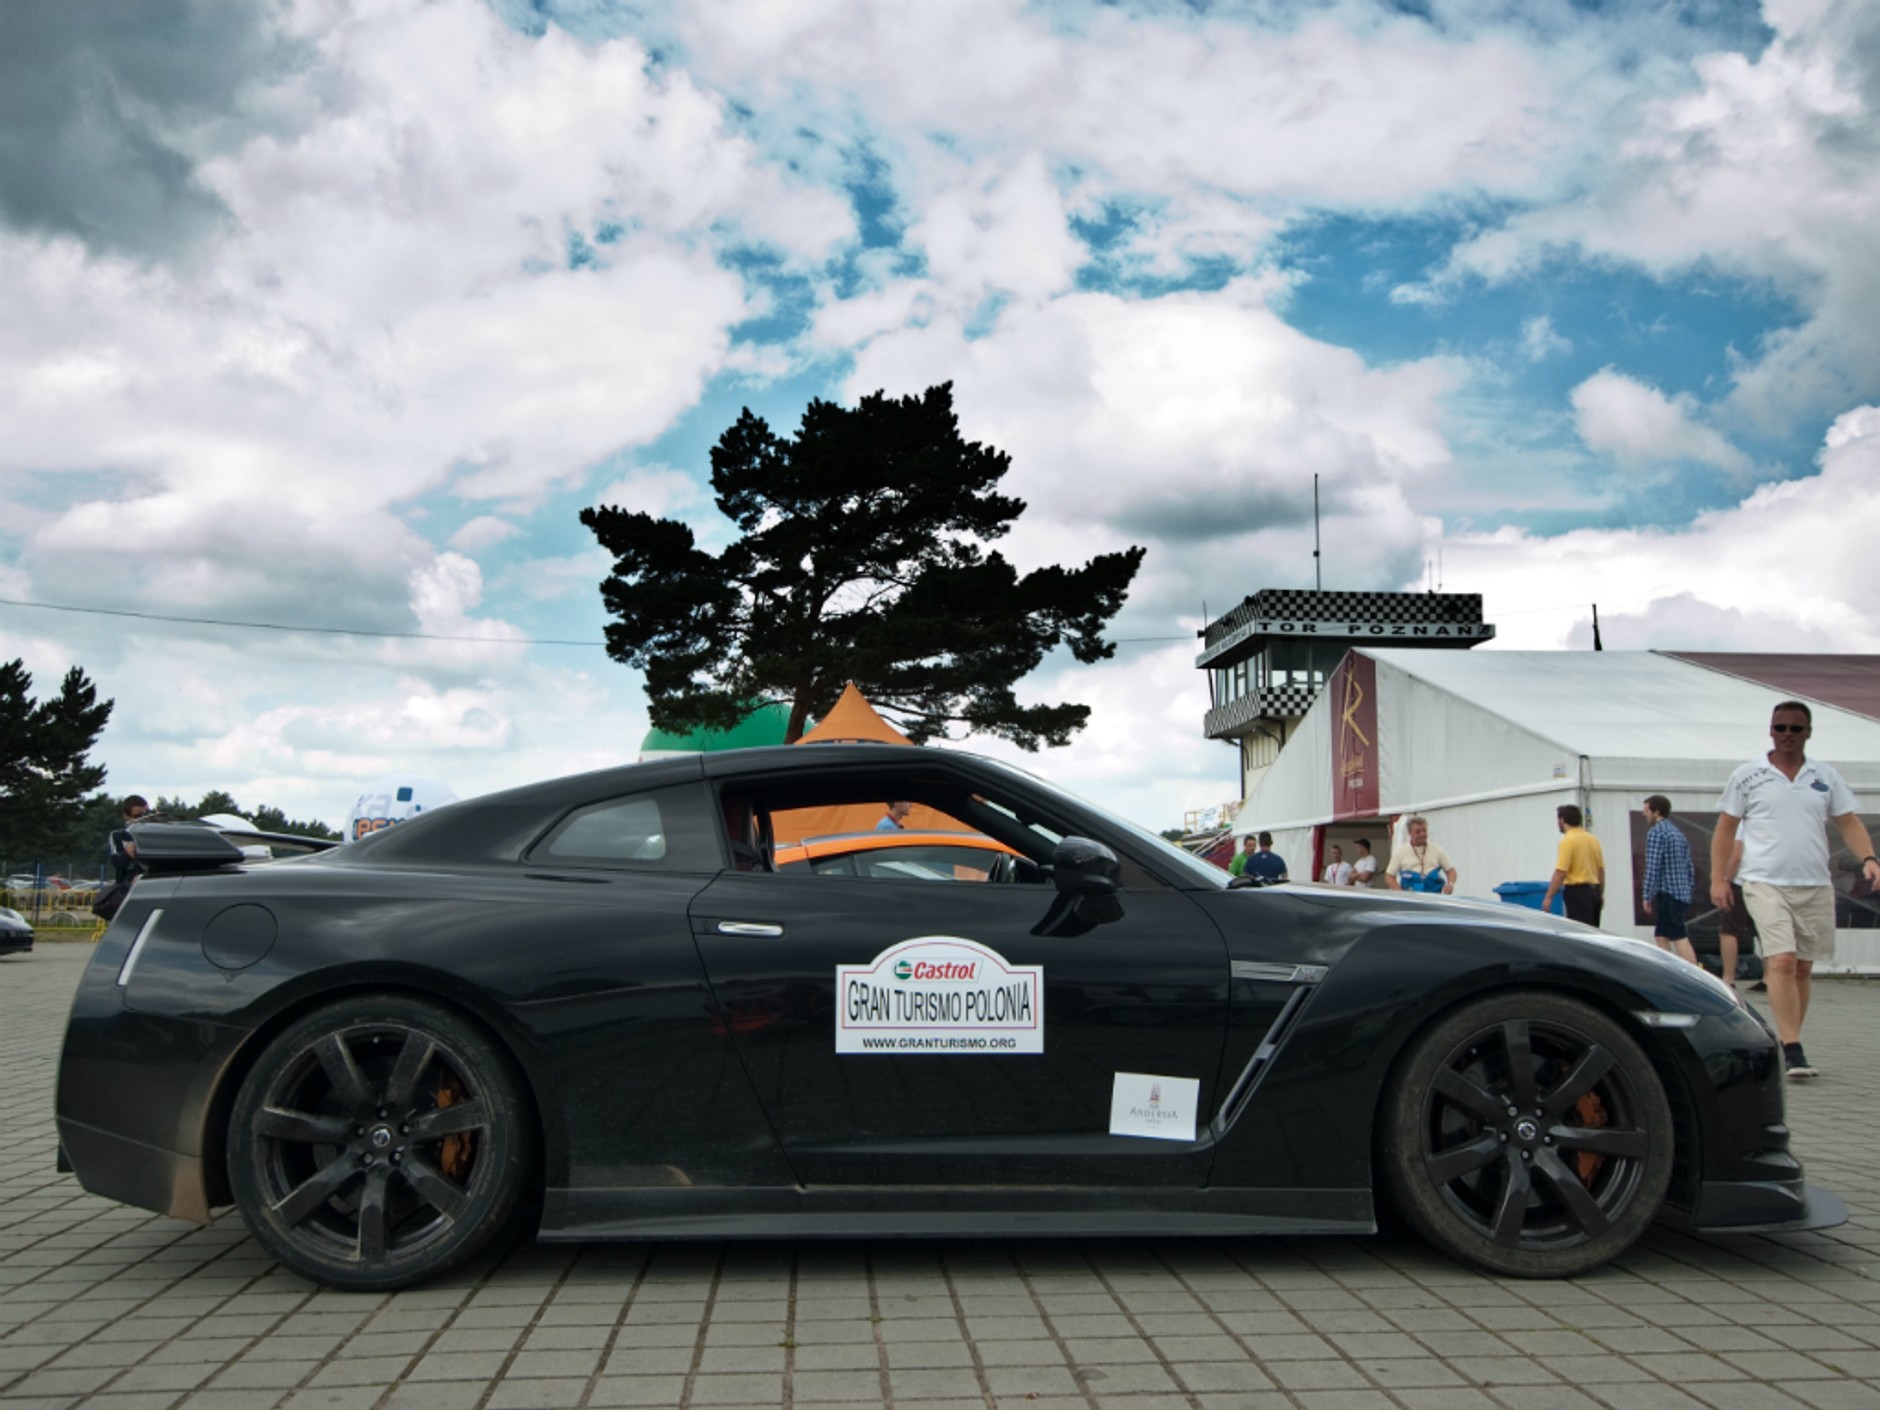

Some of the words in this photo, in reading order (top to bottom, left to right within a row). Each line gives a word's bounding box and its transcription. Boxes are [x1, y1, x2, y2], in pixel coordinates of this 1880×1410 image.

[1258, 622, 1318, 634] TOR
[914, 960, 976, 980] Castrol
[848, 980, 890, 1022] GRAN
[894, 989, 962, 1022] TURISMO
[965, 981, 1031, 1022] POLONIA
[862, 1037, 1017, 1049] WWW.GRANTURISMO.ORG
